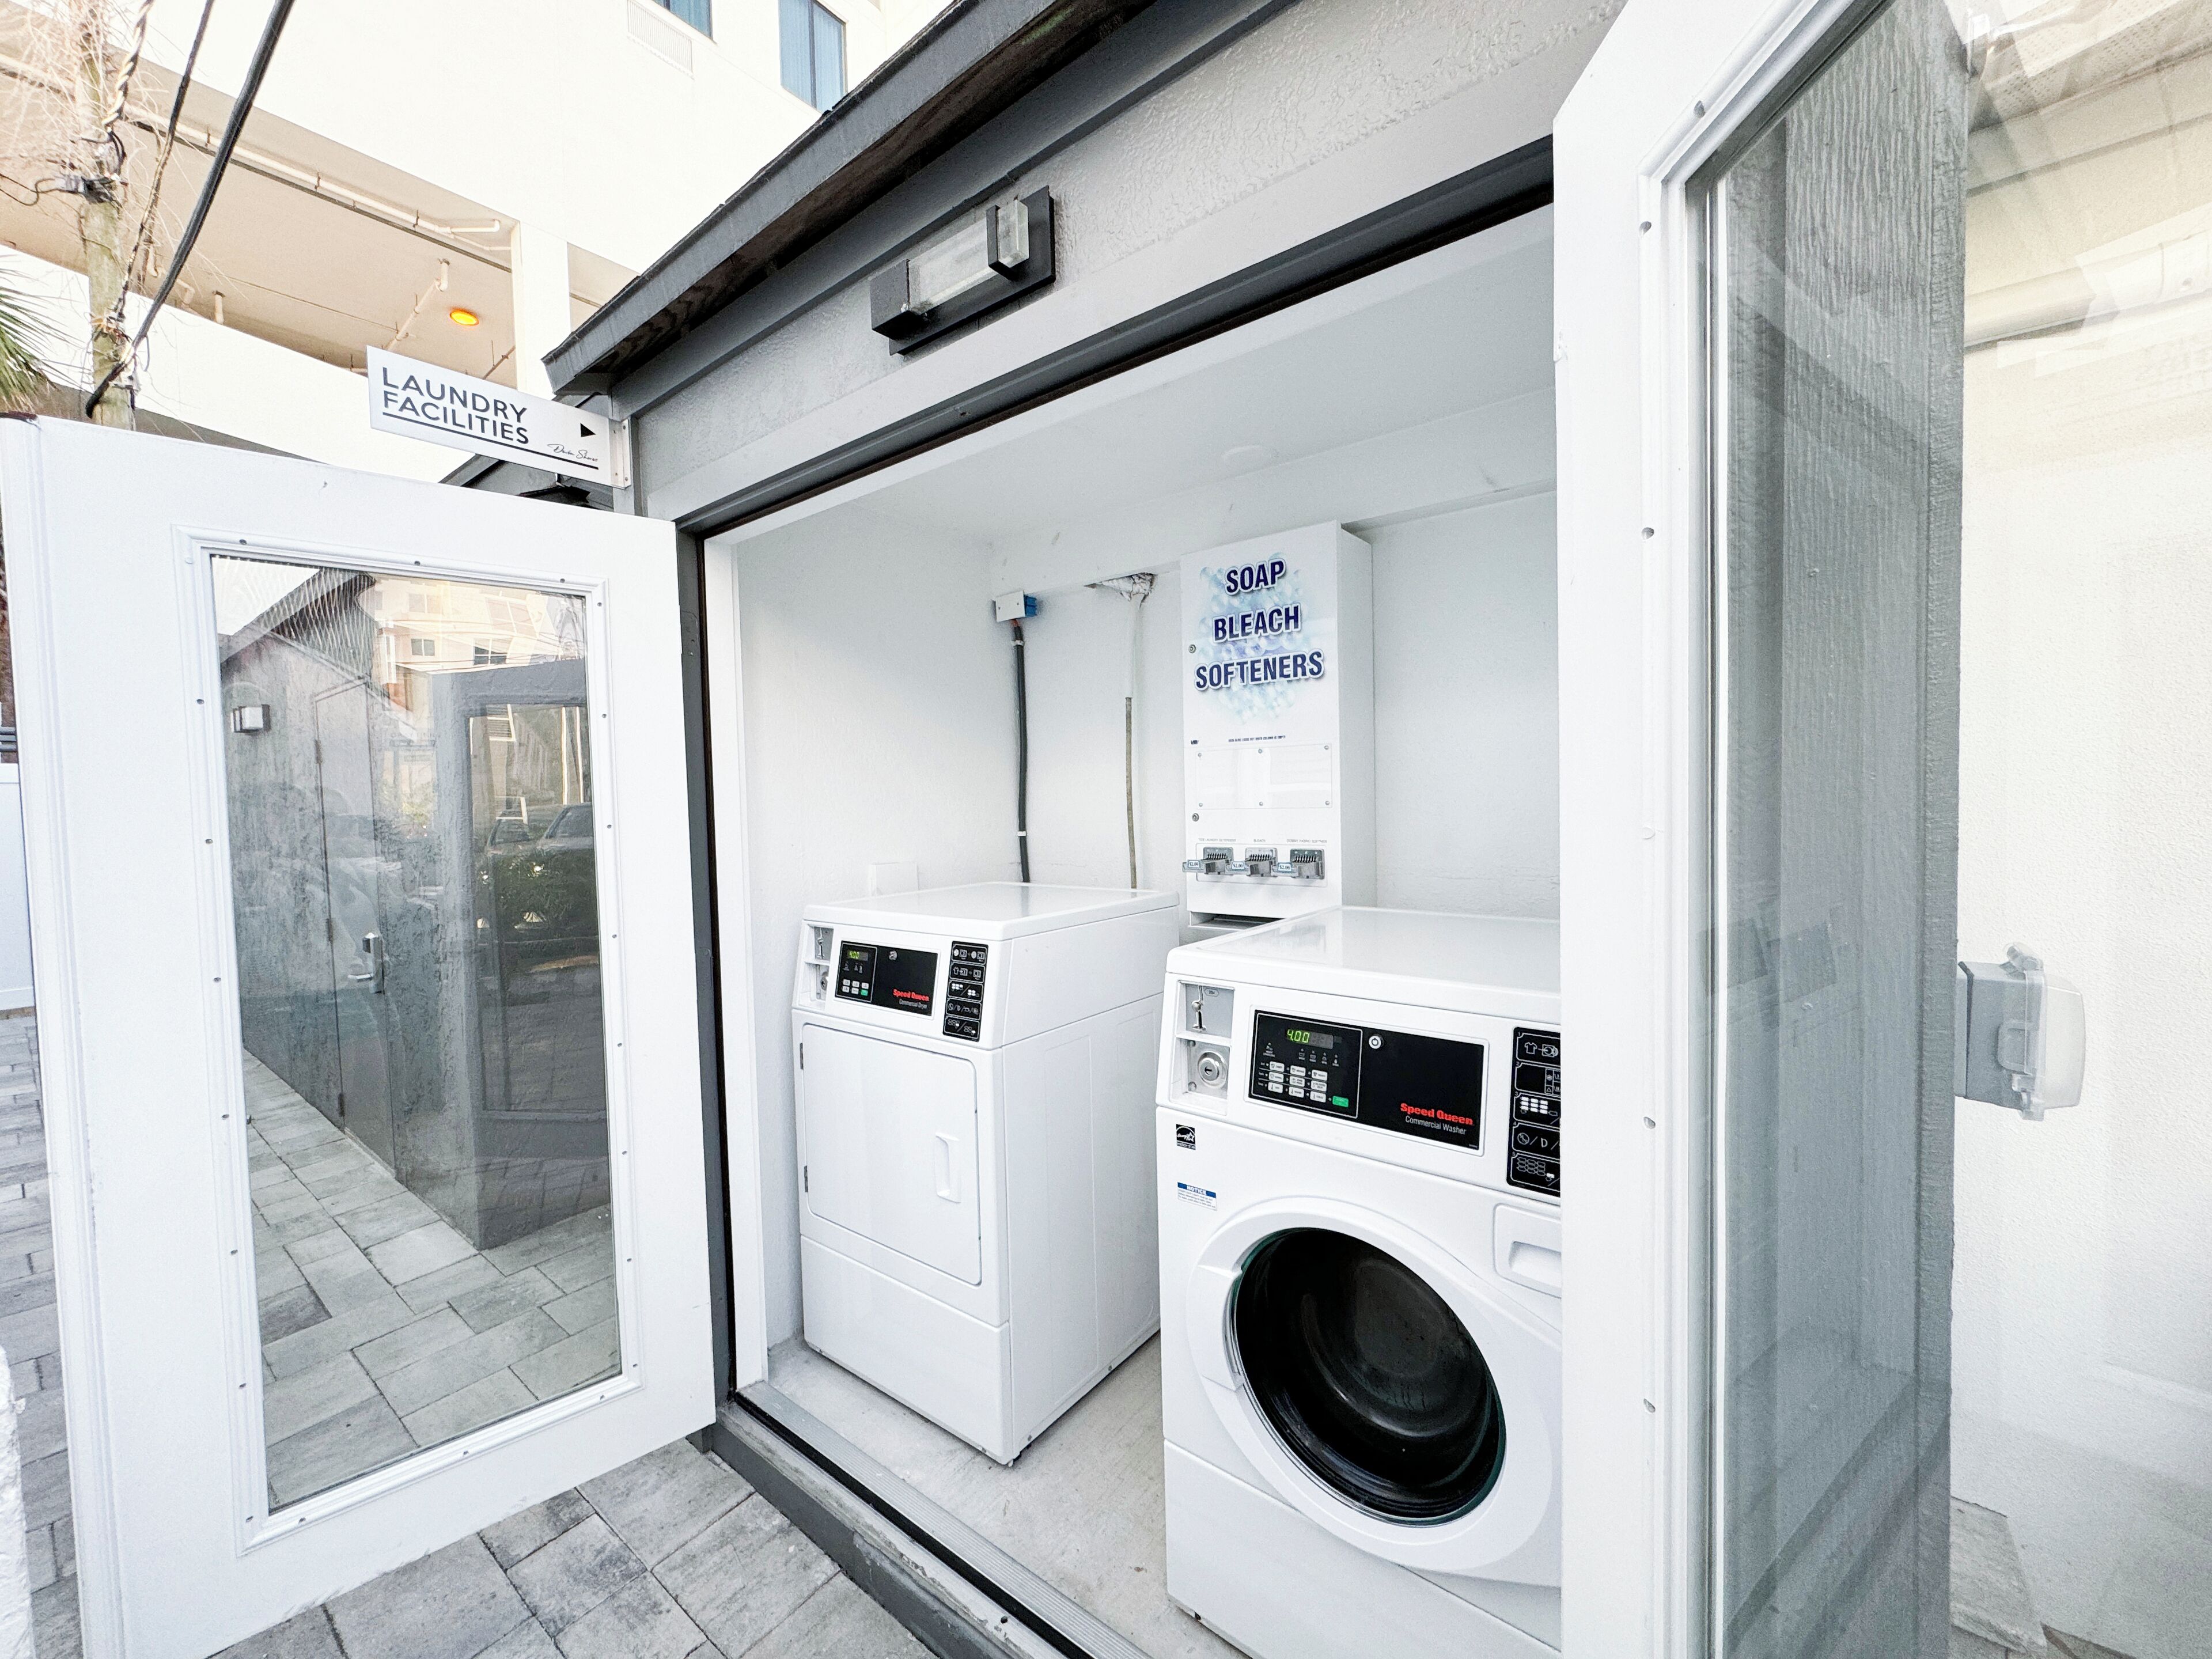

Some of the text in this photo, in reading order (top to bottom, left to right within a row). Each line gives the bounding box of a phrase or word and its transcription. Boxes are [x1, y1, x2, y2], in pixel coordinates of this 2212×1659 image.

[382, 367, 527, 423] LAUNDRY
[384, 390, 529, 444] FACILITIES
[1225, 559, 1285, 594] SOAP
[1213, 604, 1300, 641] BLEACH
[1195, 651, 1323, 689] SOFTENERS
[893, 988, 930, 1002] Speed Queen
[1286, 1029, 1310, 1043] 4.00
[1400, 1103, 1474, 1126] Speed Queen
[1405, 1115, 1466, 1135] Commercial Washer
[1187, 1185, 1207, 1195] NOTICE
